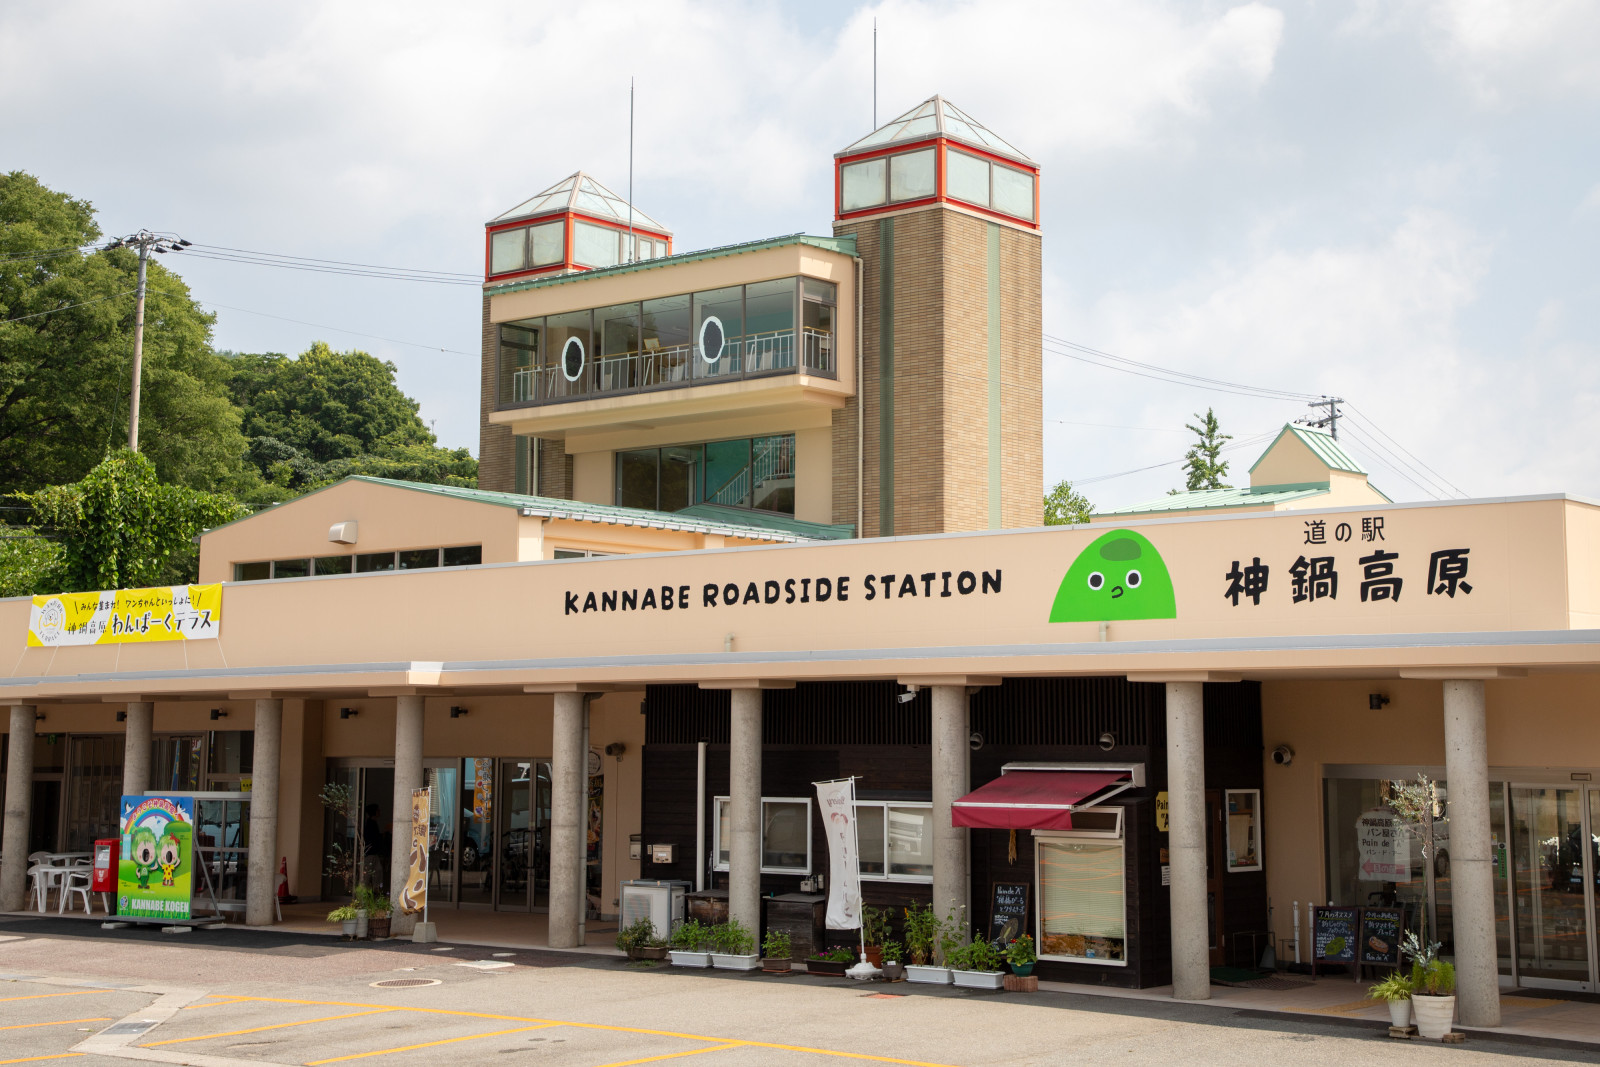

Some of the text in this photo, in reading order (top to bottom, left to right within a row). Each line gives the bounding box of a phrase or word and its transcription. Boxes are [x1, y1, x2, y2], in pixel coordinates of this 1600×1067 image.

[1303, 516, 1386, 545] 道の駅
[1224, 548, 1474, 607] 神鍋高原
[564, 569, 1002, 616] KANNABE ROADSIDE STATION
[111, 610, 212, 636] わんぱーくテラス
[1362, 839, 1378, 847] Pain
[1381, 839, 1390, 847] de
[131, 899, 189, 913] KANNABE KOGEN
